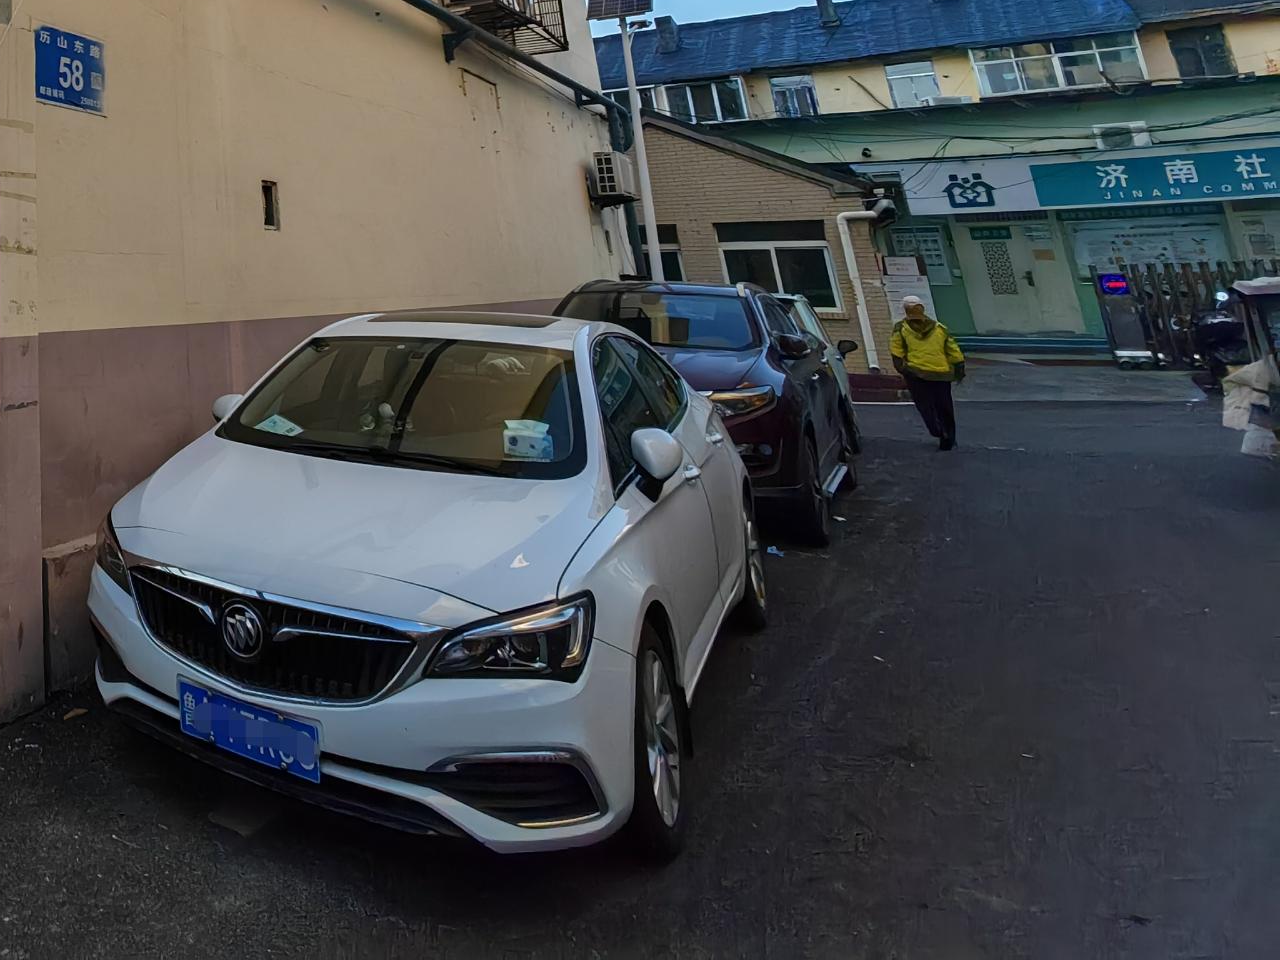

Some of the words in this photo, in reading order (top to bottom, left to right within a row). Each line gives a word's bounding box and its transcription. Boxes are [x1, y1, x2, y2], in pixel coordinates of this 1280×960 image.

[39, 30, 101, 59] 历山东路
[58, 56, 84, 92] 58
[1096, 153, 1272, 188] 济南社
[1104, 187, 1182, 200] JINAN
[1203, 181, 1277, 194] COMM
